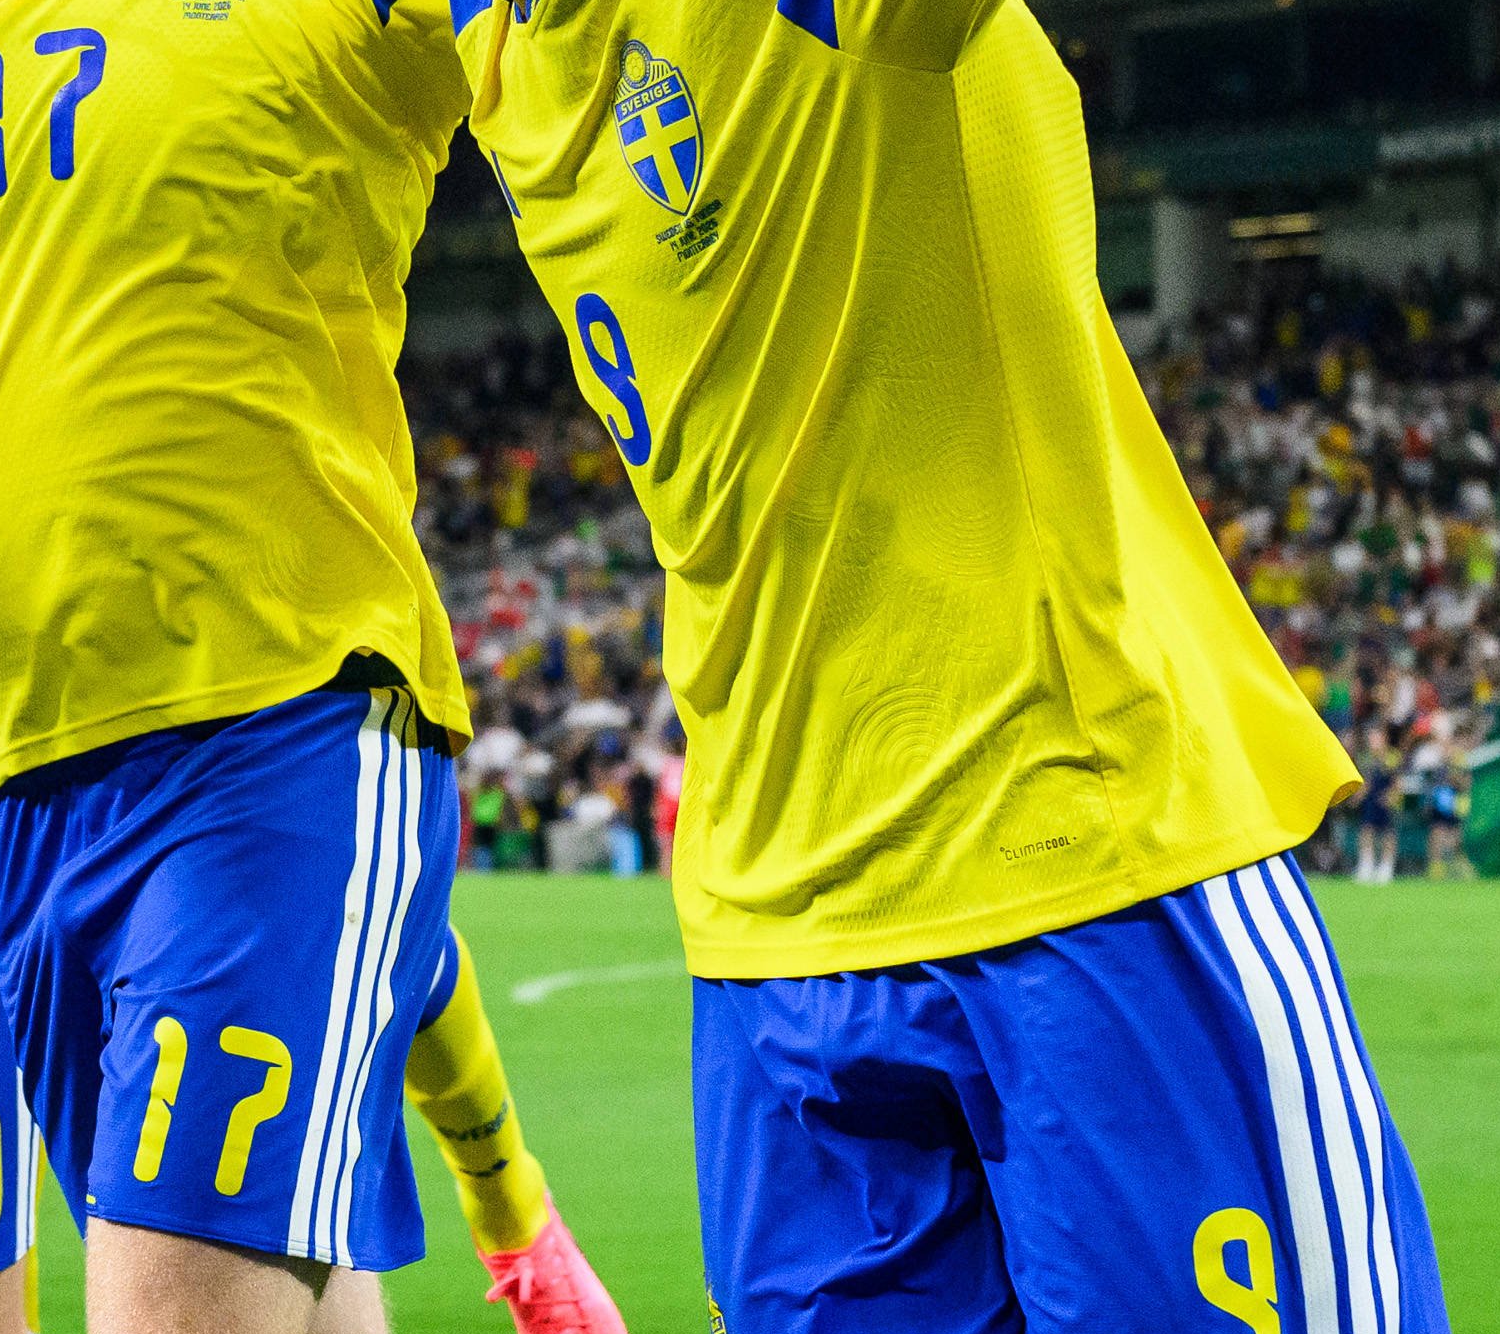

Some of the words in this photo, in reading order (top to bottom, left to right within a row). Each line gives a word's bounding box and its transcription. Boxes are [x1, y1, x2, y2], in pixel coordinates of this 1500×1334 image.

[193, 2, 212, 11] JUNE
[213, 1, 232, 11] 2026
[620, 80, 673, 117] SVERIGE
[575, 292, 652, 467] 9
[132, 1015, 294, 1198] 17
